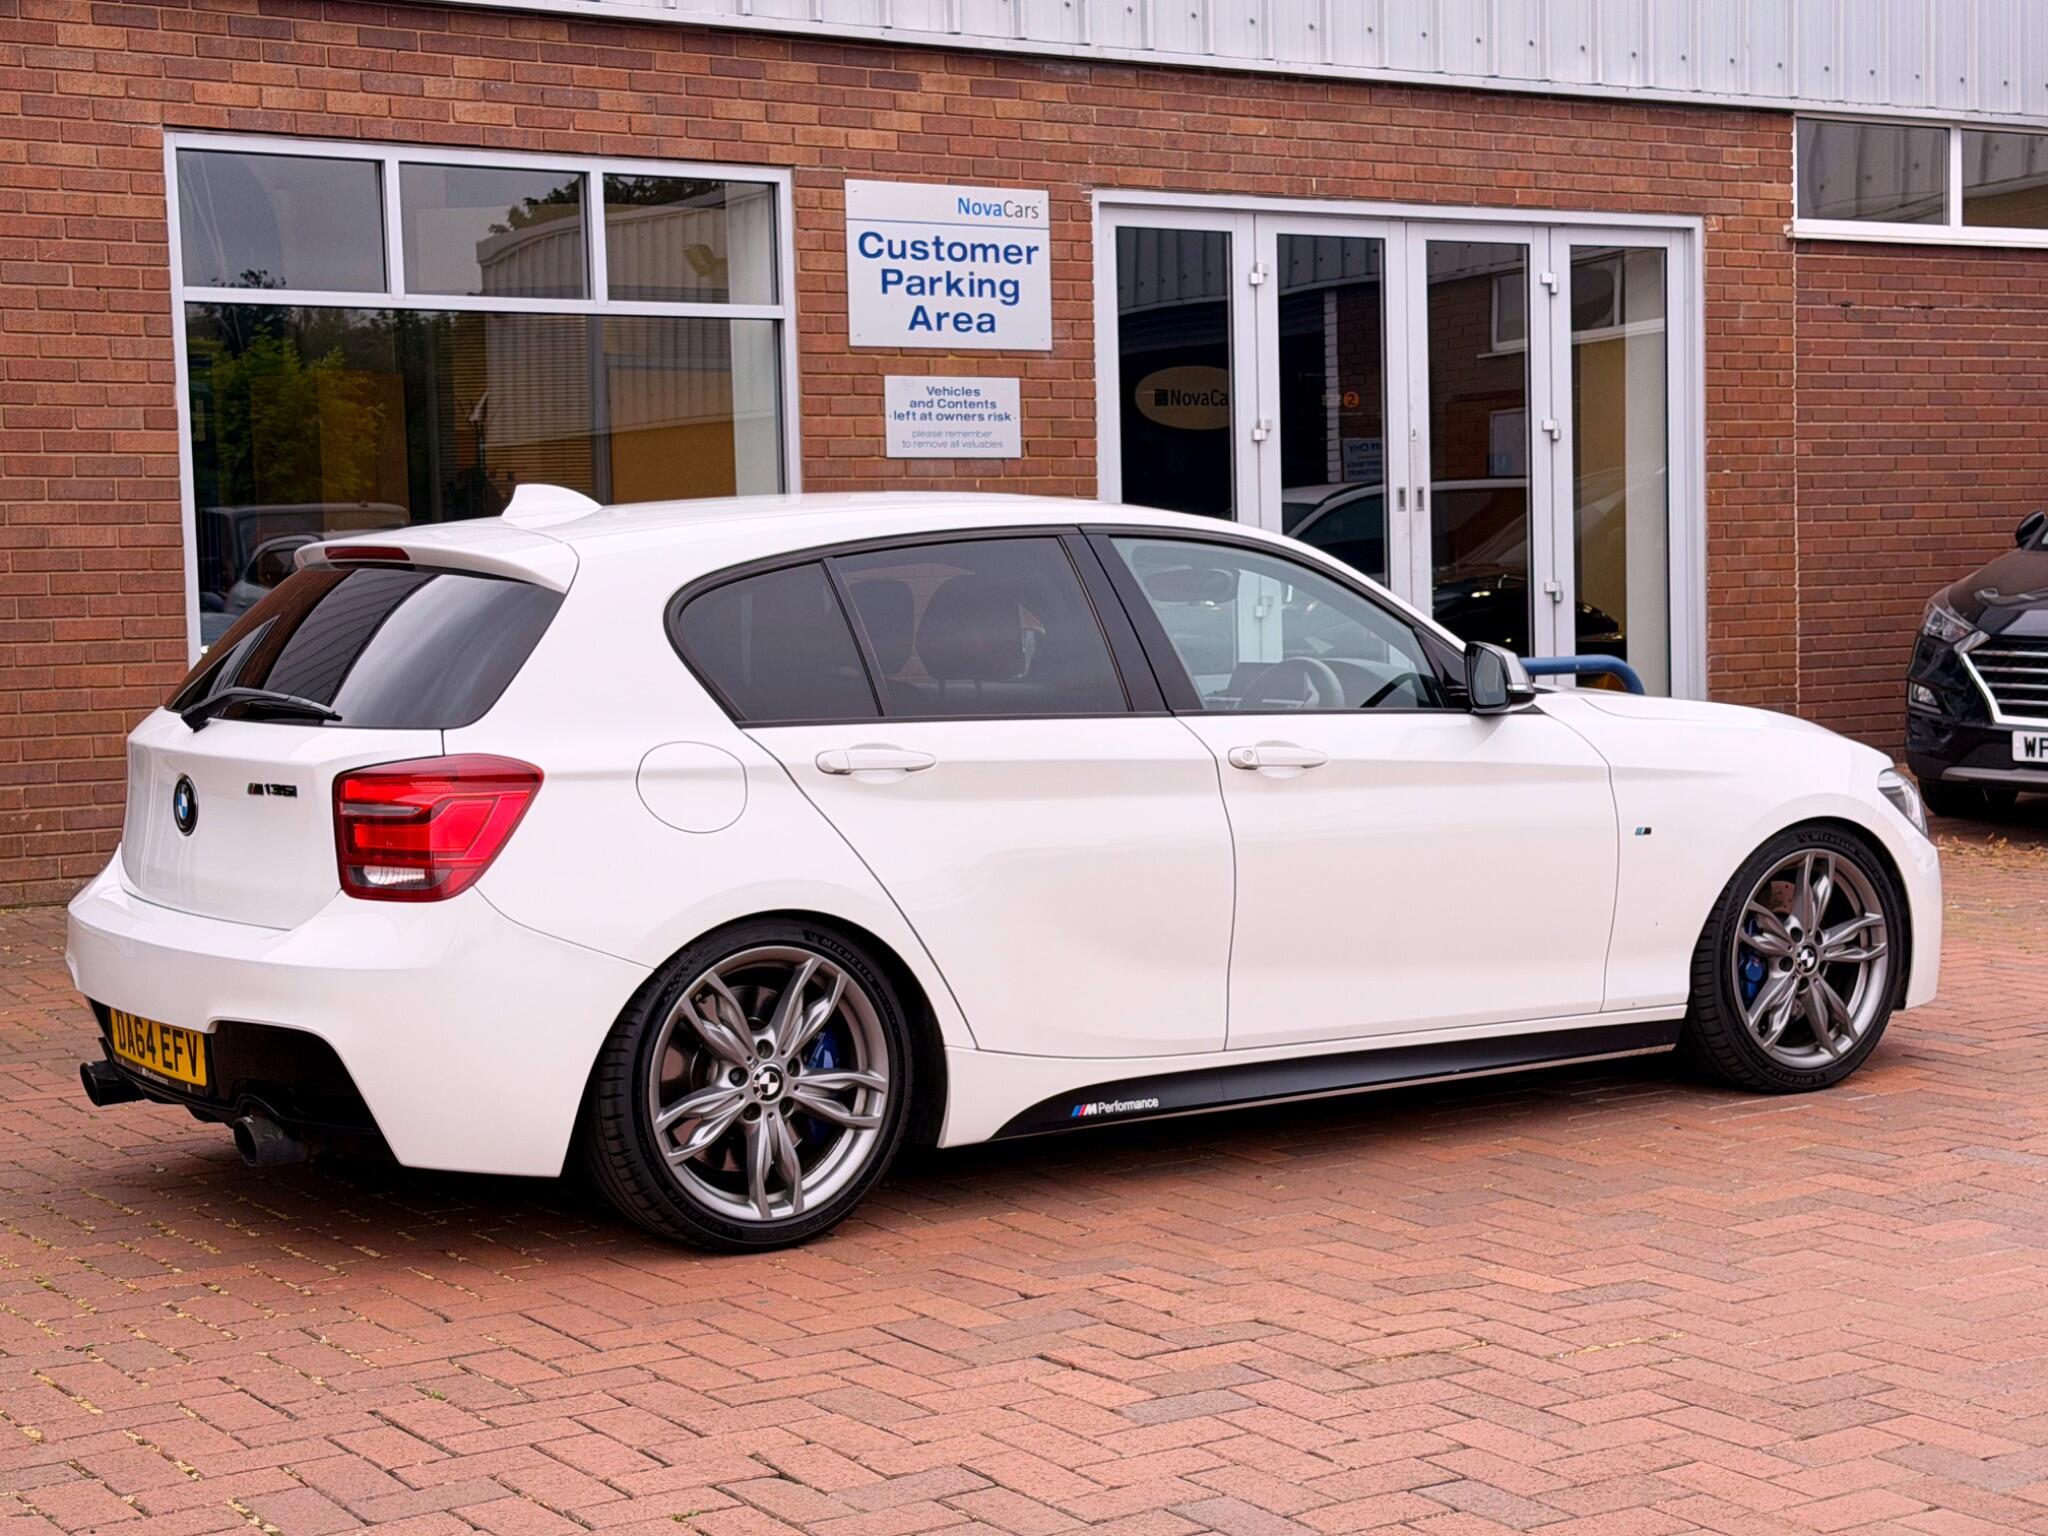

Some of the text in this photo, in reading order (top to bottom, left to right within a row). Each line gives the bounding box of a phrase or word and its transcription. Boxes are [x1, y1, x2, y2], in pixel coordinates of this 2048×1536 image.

[957, 198, 1039, 219] NovaCars
[858, 231, 1039, 264] Customer
[881, 268, 1020, 306] Parking
[908, 305, 996, 333] Area
[926, 386, 981, 397] Vehicles
[909, 399, 997, 409] and Contents
[894, 411, 1012, 422] left at owners risk
[912, 429, 992, 439] please remember
[950, 440, 959, 448] all
[962, 440, 1004, 449] valuables
[114, 1009, 197, 1078] DA64 EFV
[1098, 1098, 1159, 1114] Performance
